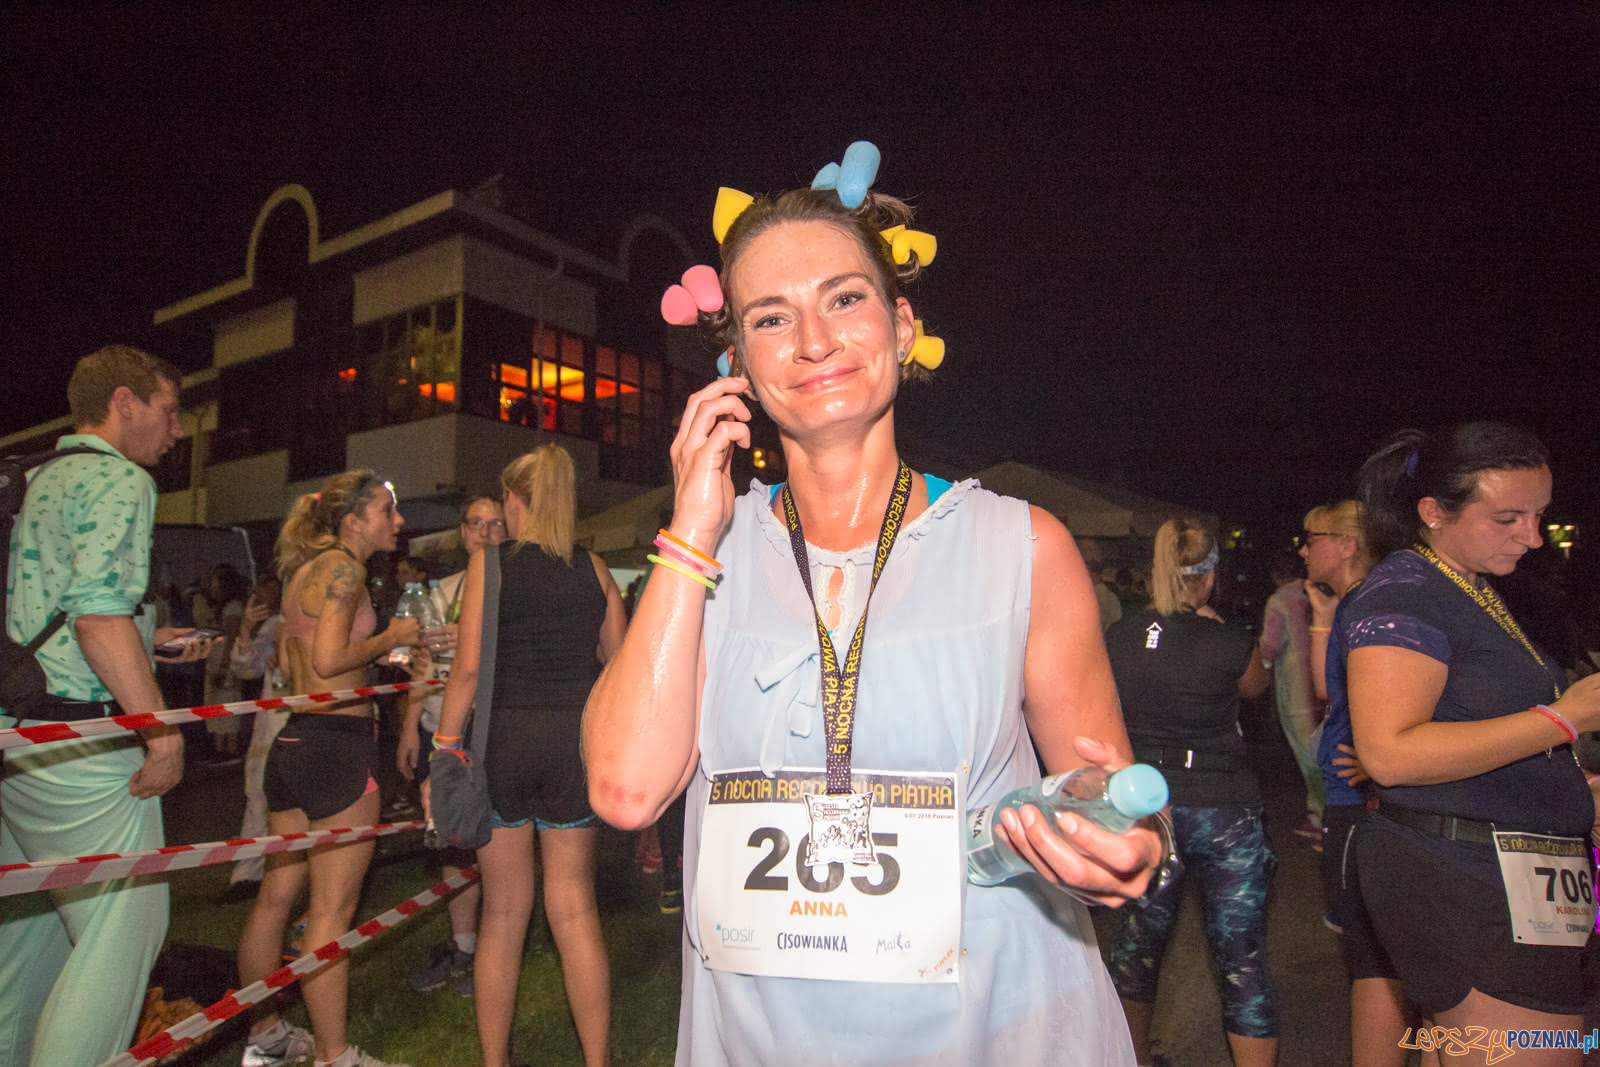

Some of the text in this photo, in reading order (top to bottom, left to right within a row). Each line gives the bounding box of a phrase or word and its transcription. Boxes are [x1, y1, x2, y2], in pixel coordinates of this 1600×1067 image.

[1437, 562, 1489, 608] RECORDOWA
[835, 677, 857, 741] NOCNA
[833, 743, 848, 755] 5
[712, 781, 721, 801] 5
[723, 778, 772, 801] NOCNA
[1534, 866, 1592, 905] 706
[789, 900, 848, 918] ANNA
[722, 927, 755, 945] posir
[777, 932, 848, 953] CISOWIANKA
[876, 932, 911, 954] Malta
